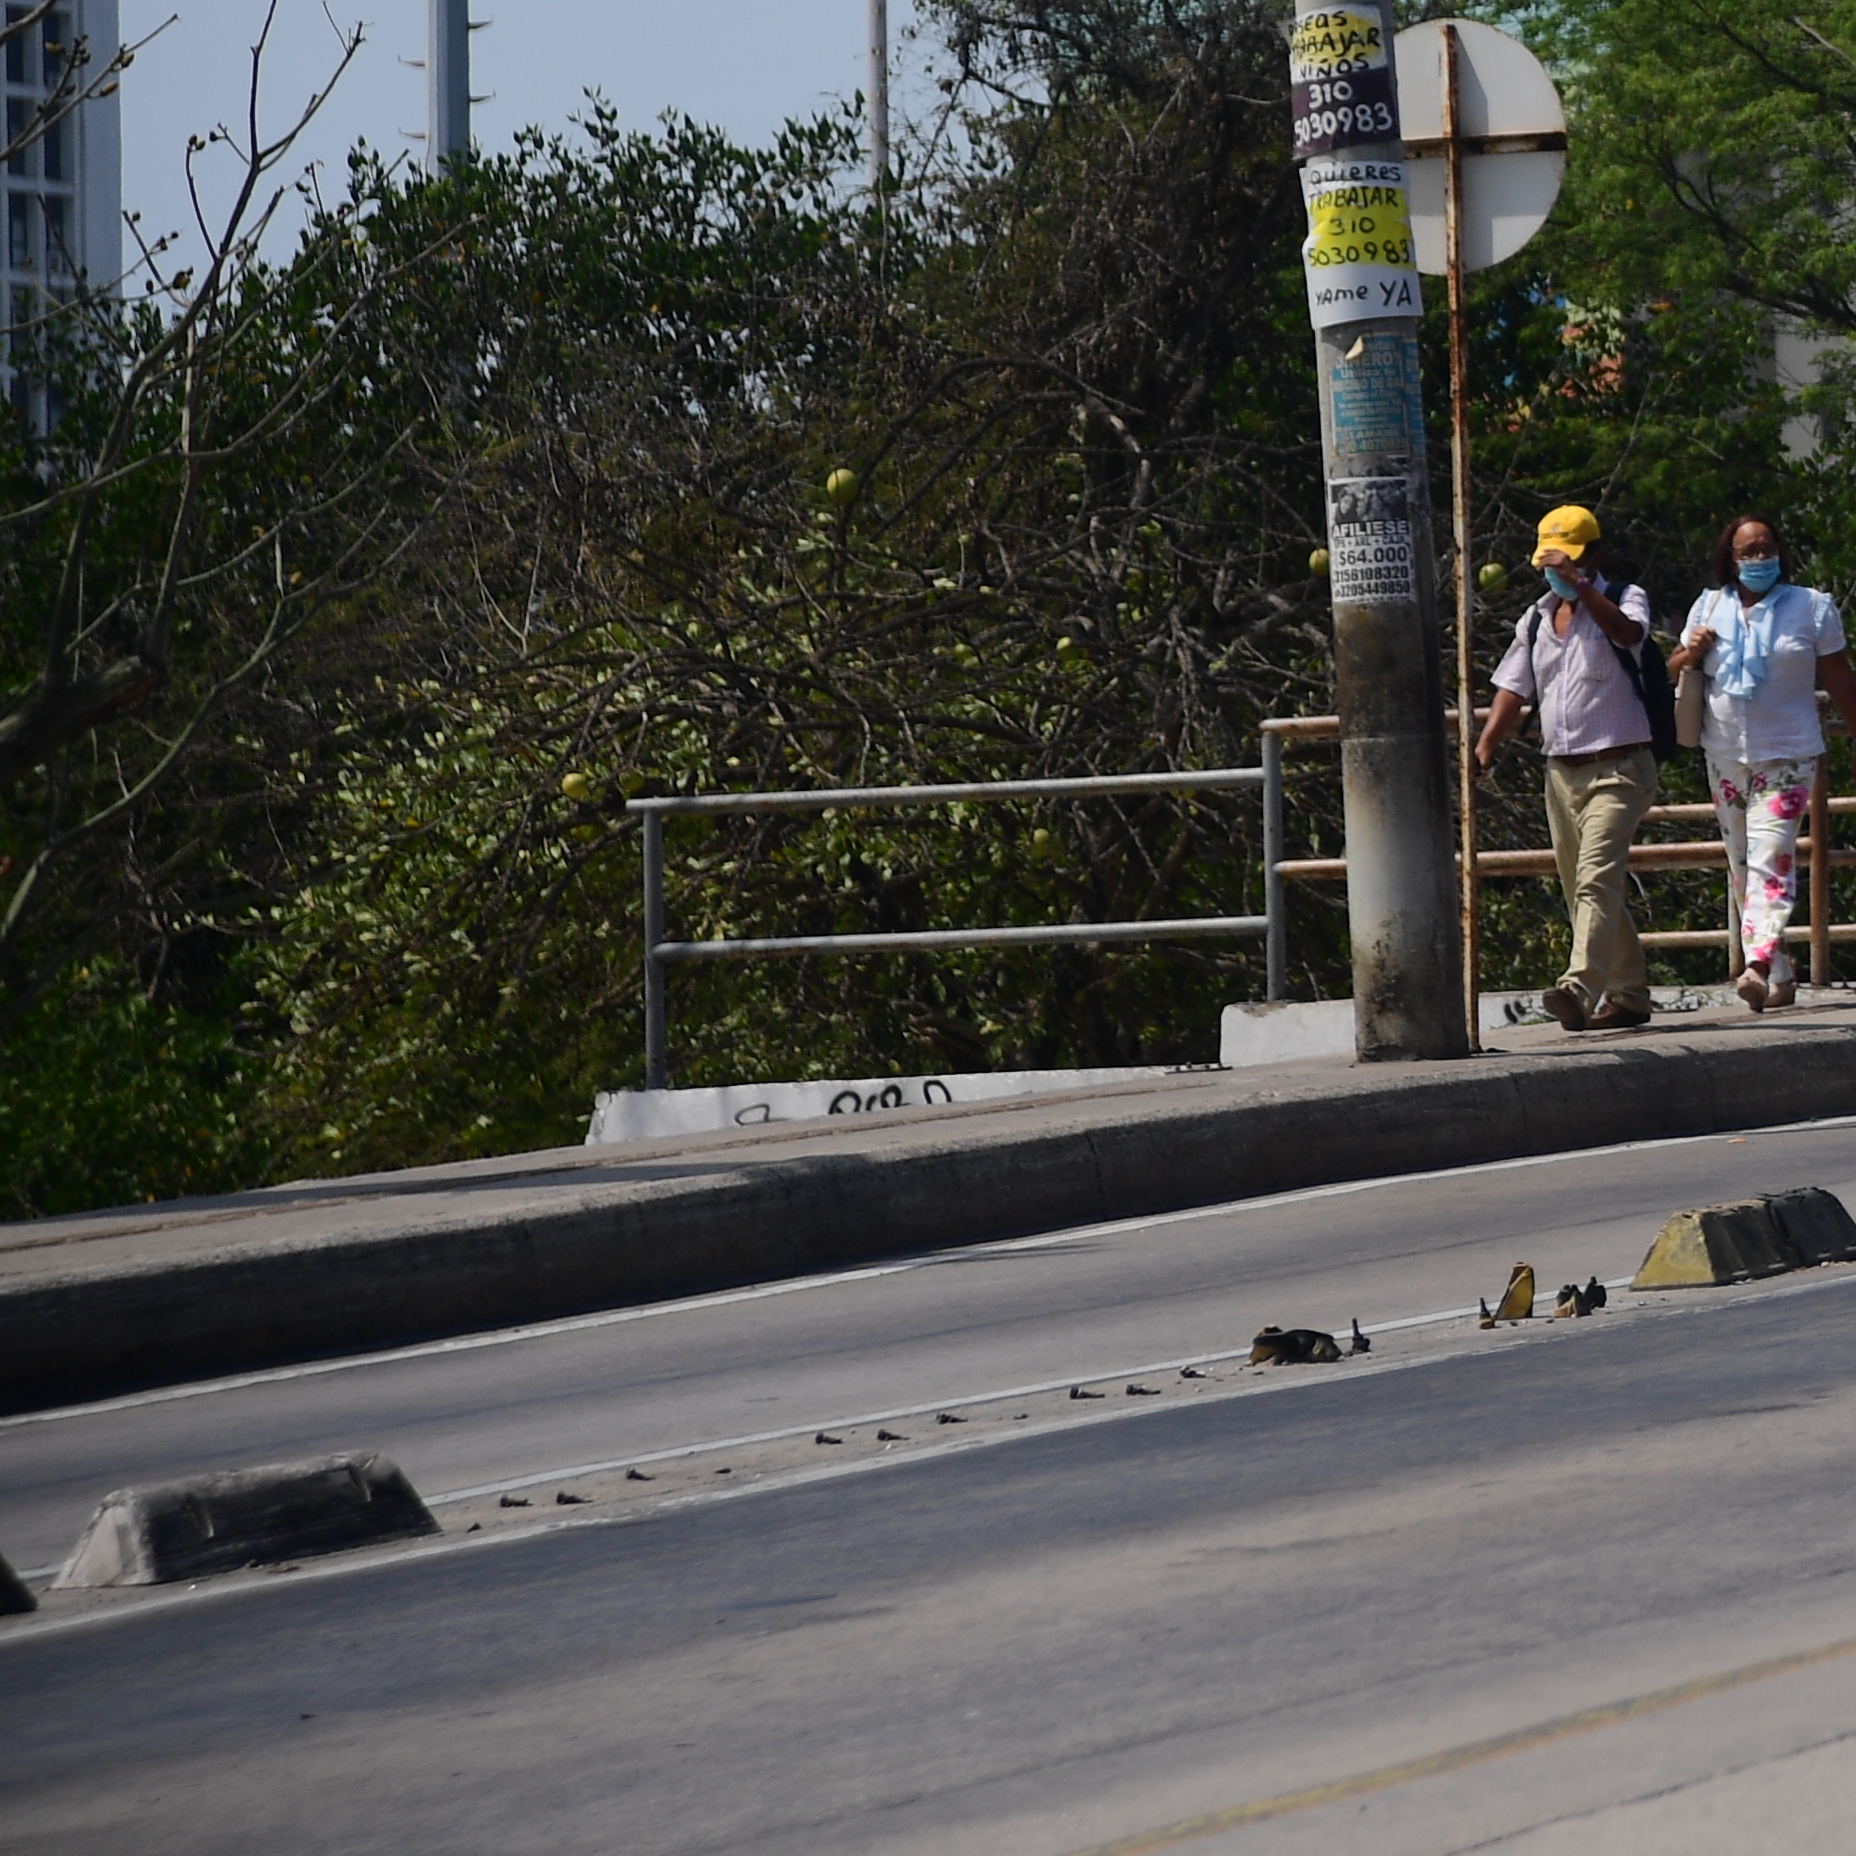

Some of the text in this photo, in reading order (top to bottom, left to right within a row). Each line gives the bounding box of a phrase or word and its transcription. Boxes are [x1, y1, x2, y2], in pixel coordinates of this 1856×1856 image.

[1309, 80, 1353, 109] 310
[1294, 102, 1392, 148] 5030983
[1329, 216, 1375, 236] 310
[1307, 238, 1410, 266] 5030983
[1379, 278, 1412, 306] YA
[1332, 520, 1407, 538] AFILIESE
[1339, 546, 1408, 566] $64.000
